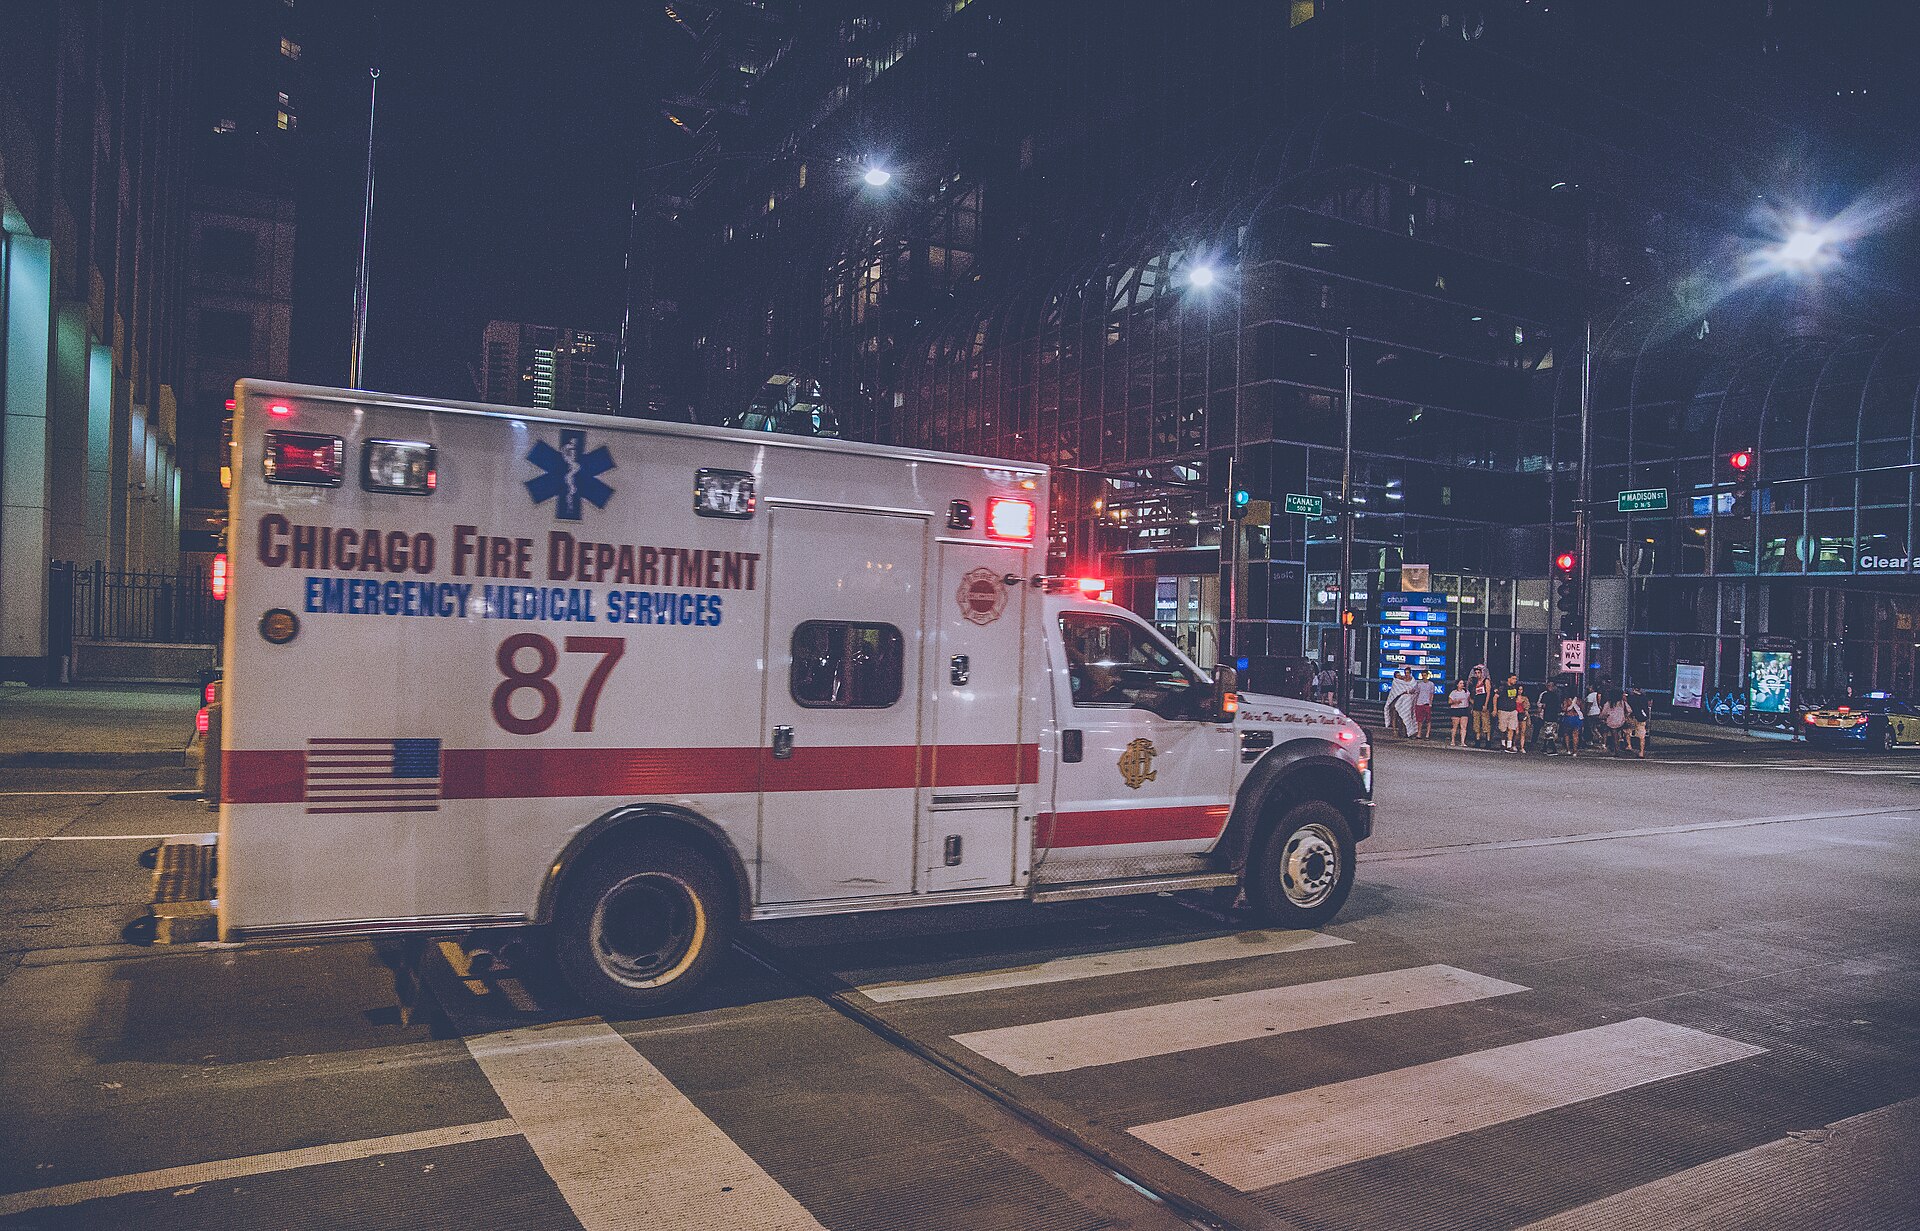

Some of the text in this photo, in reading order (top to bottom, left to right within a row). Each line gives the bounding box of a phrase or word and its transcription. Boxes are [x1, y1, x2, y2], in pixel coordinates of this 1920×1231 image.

[1292, 497, 1314, 507] CANAL
[1626, 491, 1657, 502] MADISON
[257, 514, 761, 591] CHICAGO FIRE DEPARTMENT
[1860, 555, 1908, 568] Clear
[304, 577, 723, 627] EMERGENCY MEDICAL SERVICES
[1420, 642, 1441, 650] NOKIA
[1566, 643, 1581, 651] ONE
[1565, 651, 1581, 660] WAY
[491, 632, 627, 736] 87
